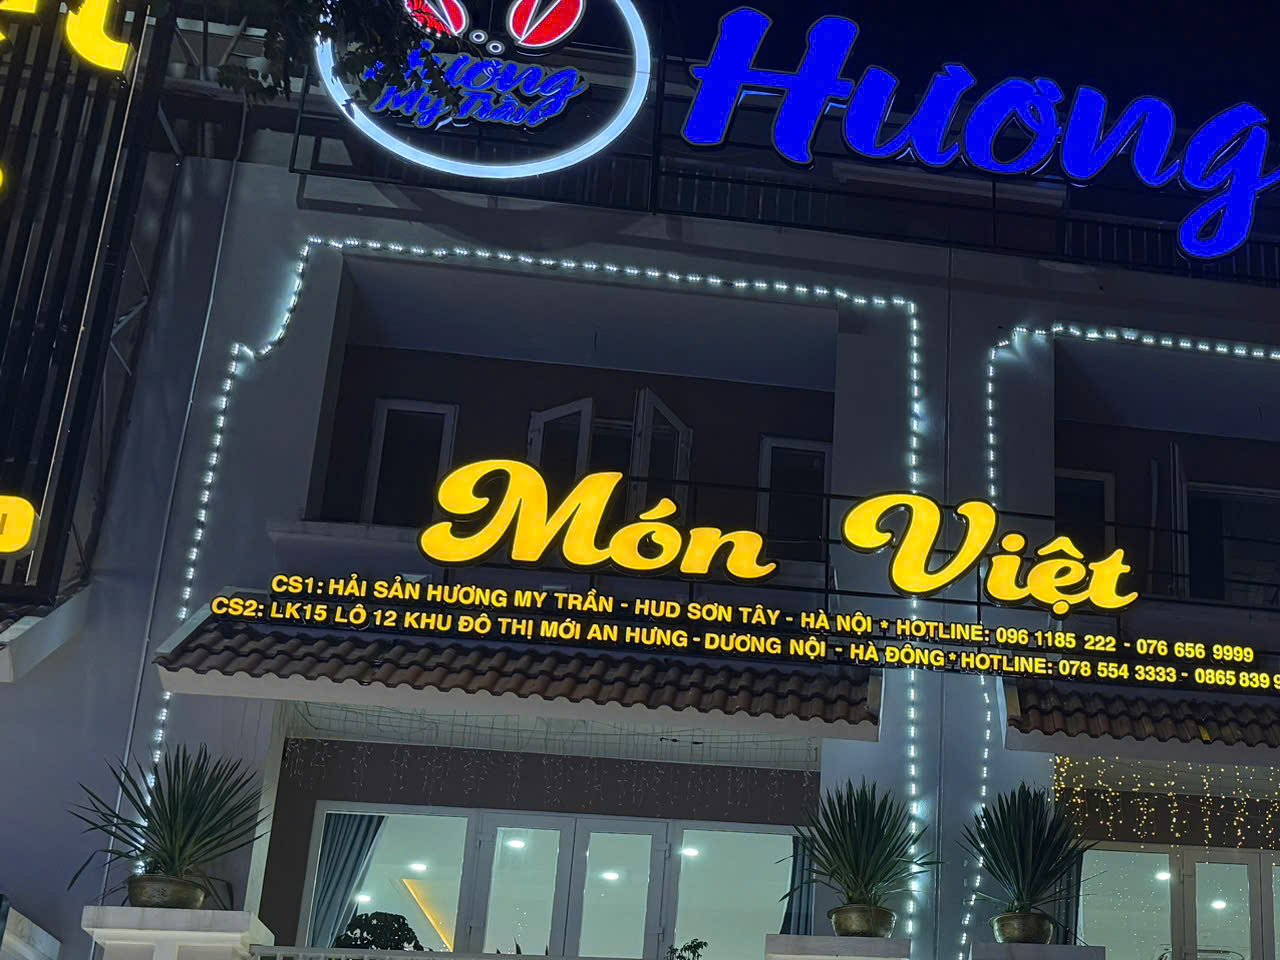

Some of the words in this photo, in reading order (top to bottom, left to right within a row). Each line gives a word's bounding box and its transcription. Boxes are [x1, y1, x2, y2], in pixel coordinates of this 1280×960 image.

[420, 459, 777, 579] Món
[843, 493, 1139, 615] Việt
[211, 596, 264, 617] CS2:
[271, 602, 327, 621] LK15
[335, 603, 367, 625] LÔ
[375, 610, 398, 627] 12
[404, 612, 452, 631] KHU
[457, 612, 492, 634] ĐÔ
[498, 617, 534, 640] THỊ
[539, 617, 581, 640] MỚI
[586, 623, 618, 642] AN
[625, 626, 688, 647] HƯNG
[704, 632, 782, 654] DƯƠNG
[789, 635, 826, 660] NỘI
[850, 641, 879, 662] HÀ
[885, 644, 945, 667] ĐÔNG
[961, 652, 1053, 675] HOTLINE:
[1058, 659, 1092, 677] 078
[1097, 661, 1129, 679] 554
[1135, 665, 1177, 683] 3333
[1194, 667, 1237, 686] 0865
[1239, 671, 1271, 689] 839
[271, 575, 324, 594] CS1:
[328, 573, 367, 597] HẢI
[373, 575, 421, 600] SẢN
[427, 583, 508, 608] HƯƠNG
[514, 591, 547, 608] MY
[554, 588, 614, 613] TRẦN
[634, 599, 681, 618] HUD
[687, 603, 733, 623] SƠN
[739, 604, 781, 625] TÂY
[801, 610, 830, 630] HÀ
[836, 612, 872, 636] NỘI
[896, 619, 990, 641] HOTLINE:
[995, 627, 1029, 645] 096
[1035, 631, 1076, 649] 1185
[1084, 634, 1116, 652] 222
[1136, 638, 1169, 656] 076
[1174, 642, 1206, 659] 656
[1212, 644, 1254, 663] 9999
